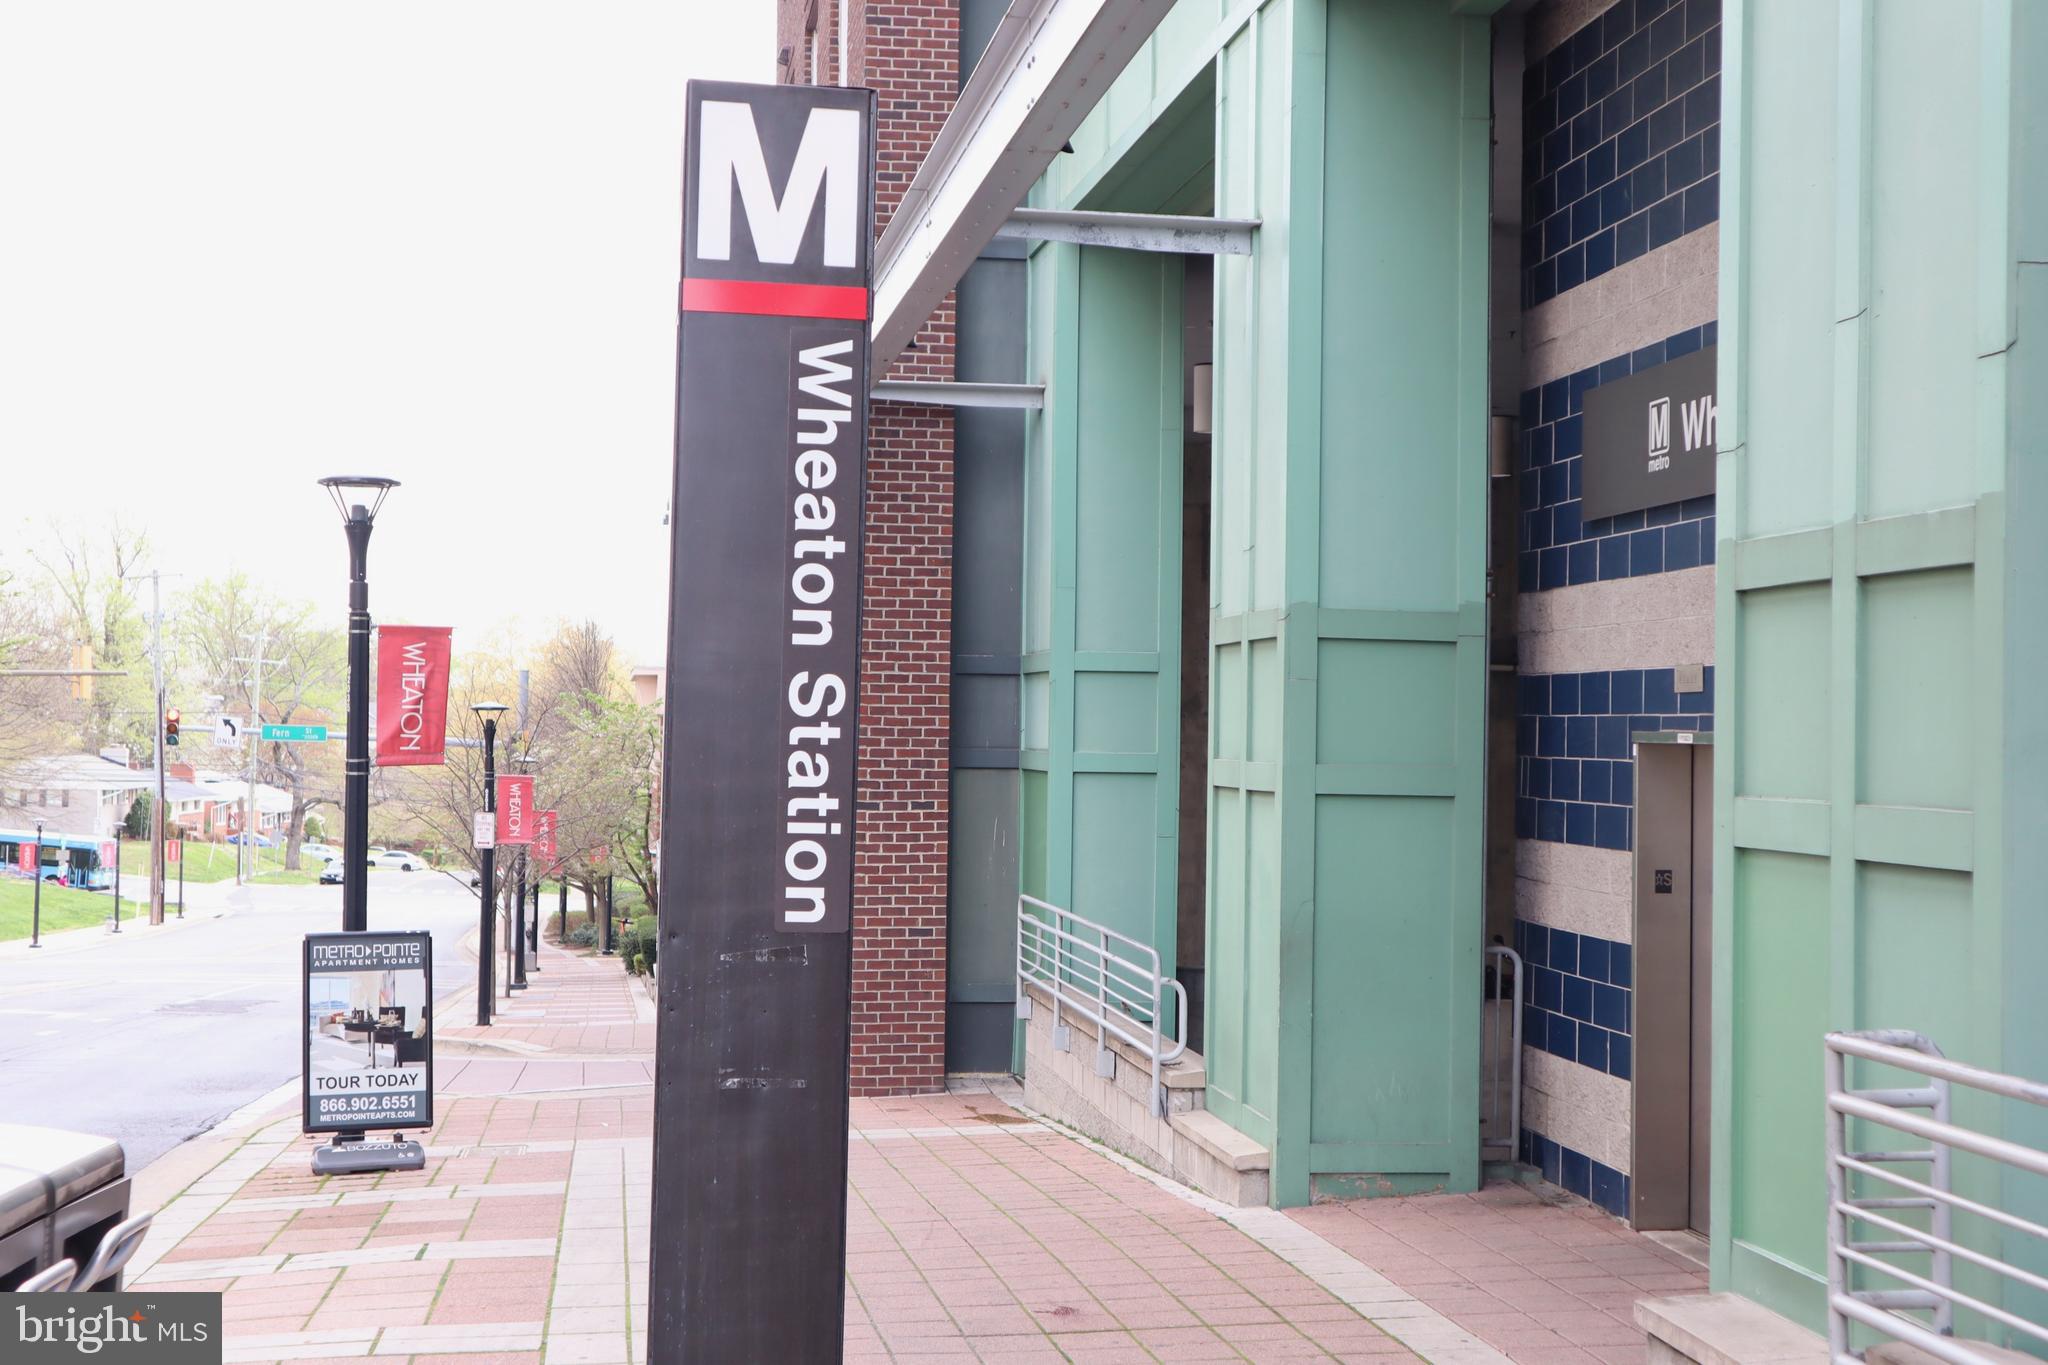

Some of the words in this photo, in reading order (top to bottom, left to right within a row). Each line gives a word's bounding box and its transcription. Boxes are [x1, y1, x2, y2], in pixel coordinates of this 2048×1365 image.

[697, 100, 860, 268] M
[1650, 402, 1668, 451] M
[1648, 455, 1670, 473] metro
[791, 339, 854, 646] Wheaton
[399, 641, 427, 751] WHEATON
[272, 728, 290, 738] Fern
[508, 782, 521, 837] WHEATON
[784, 670, 847, 923] Station
[314, 958, 378, 967] APARTMENT
[383, 957, 420, 965] HOMES
[316, 1075, 361, 1090] TOUR
[365, 1073, 419, 1088] TODAY
[319, 1094, 416, 1113] 866.902.6551
[319, 1110, 416, 1122] METROPOINTEAPTS.COM
